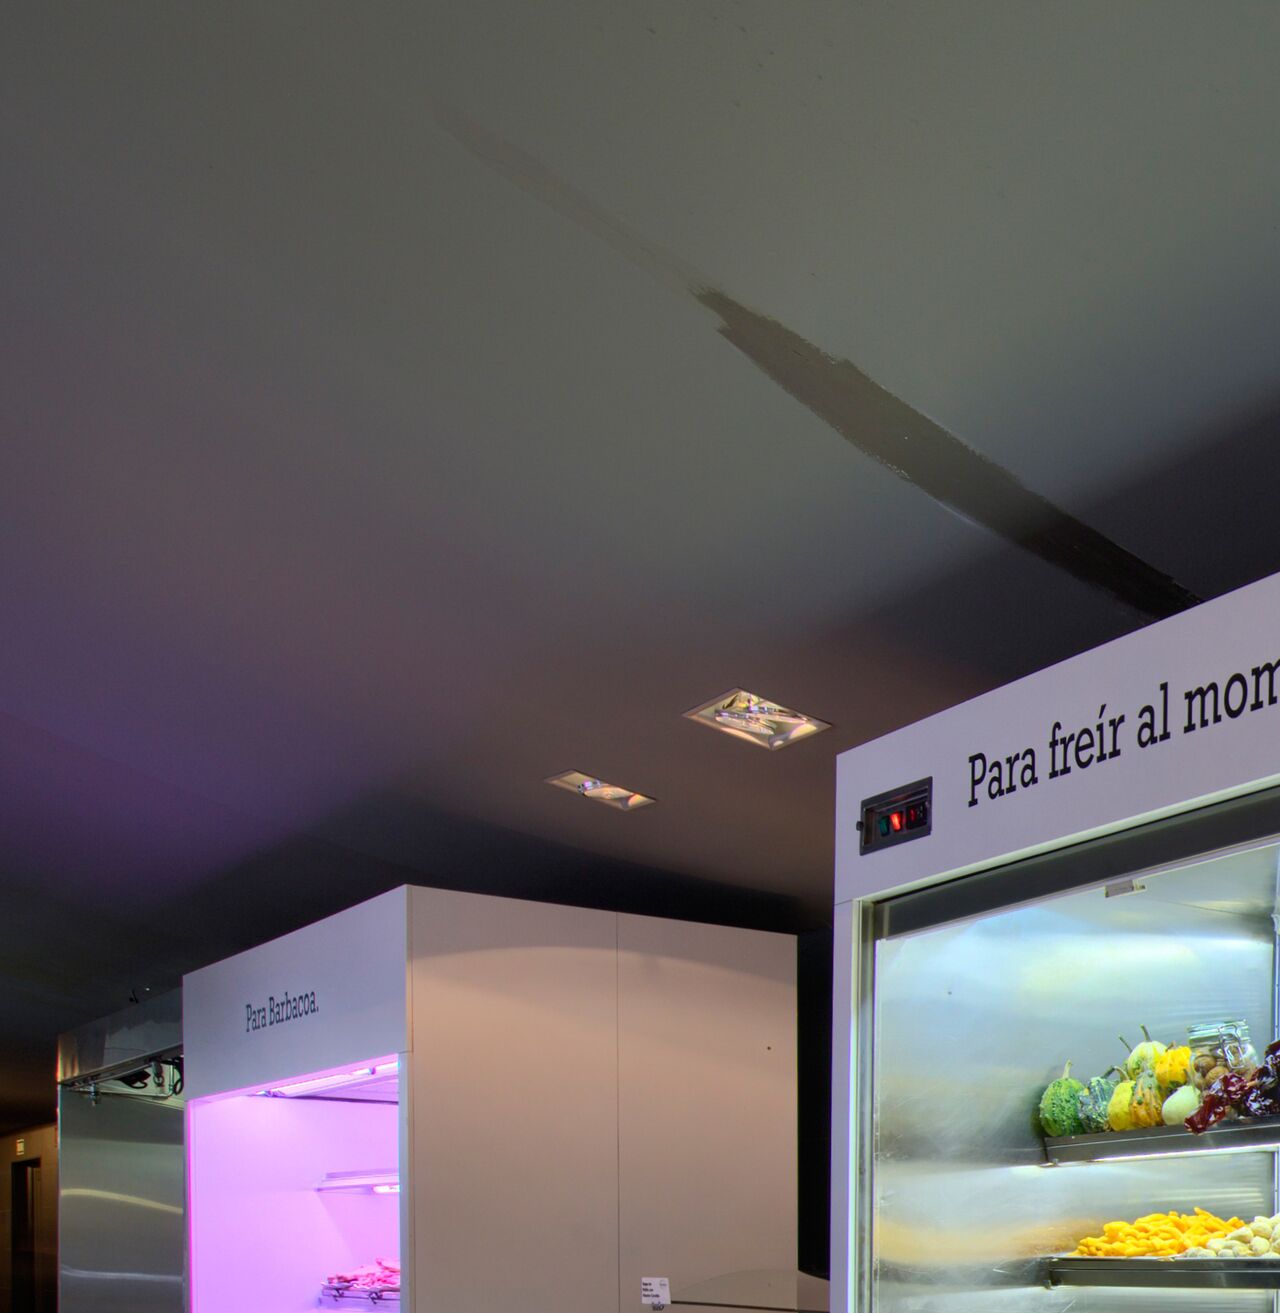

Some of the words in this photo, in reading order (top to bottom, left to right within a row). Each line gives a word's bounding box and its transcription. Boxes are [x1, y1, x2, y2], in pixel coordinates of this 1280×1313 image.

[968, 748, 1038, 807] Para
[1049, 704, 1125, 779] freír
[1138, 682, 1170, 748] al
[246, 1004, 267, 1033] Para
[269, 991, 319, 1026] Barbacoa.
